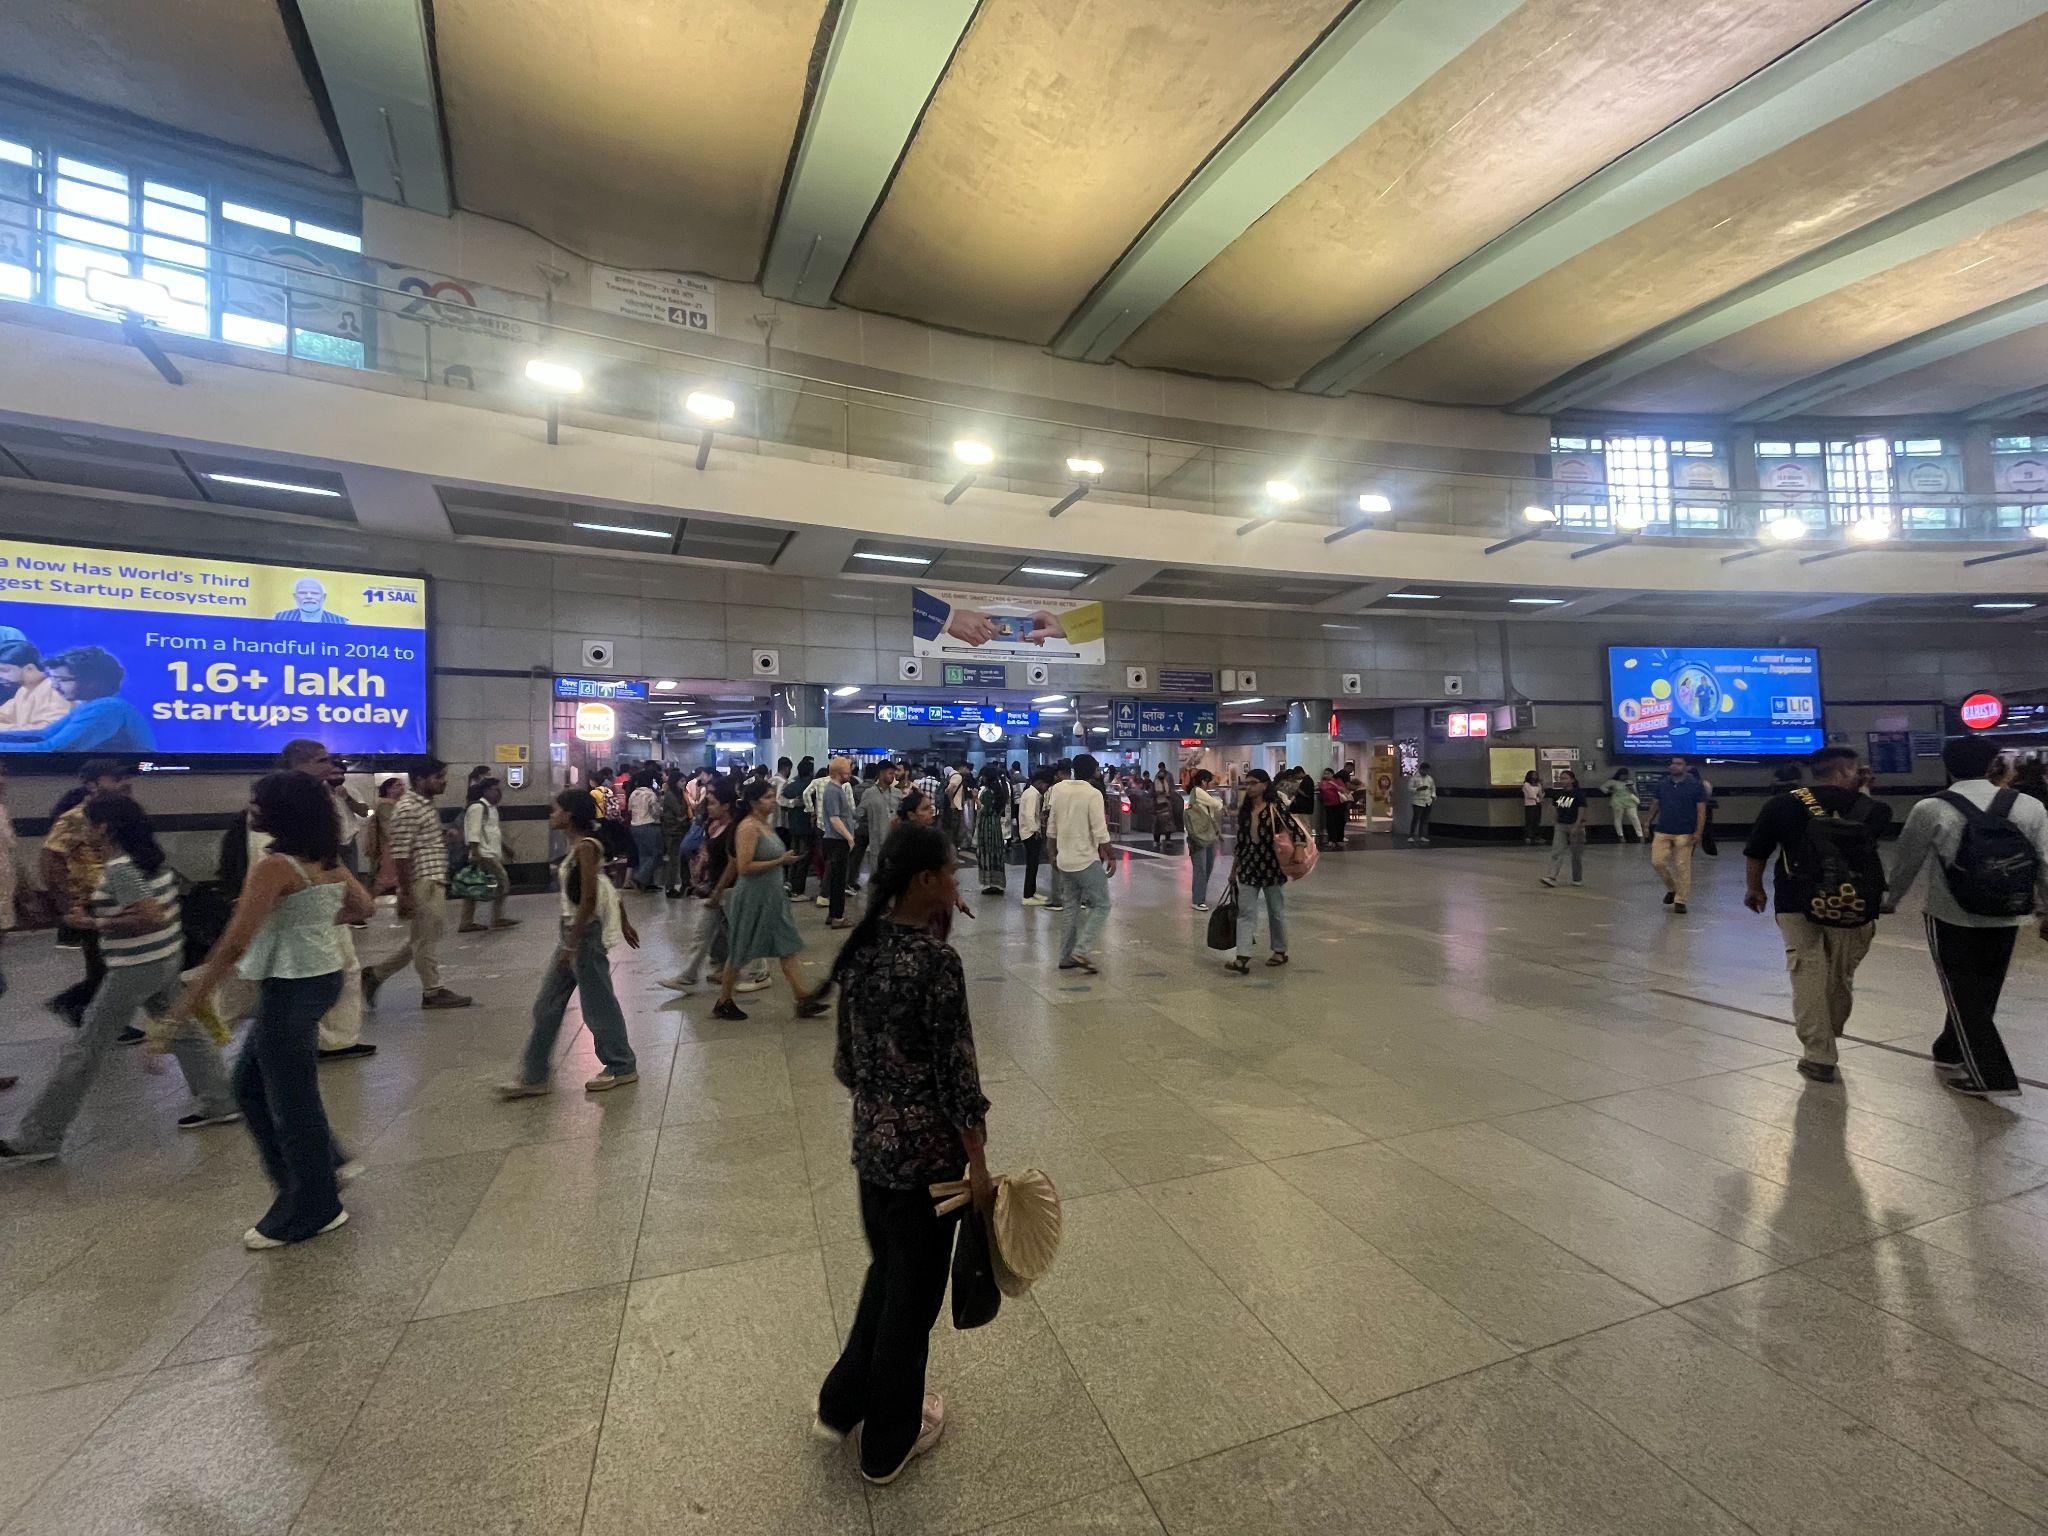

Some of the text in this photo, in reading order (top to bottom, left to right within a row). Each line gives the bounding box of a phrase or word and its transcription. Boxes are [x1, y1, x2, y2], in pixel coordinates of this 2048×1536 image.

[671, 310, 683, 323] 4
[16, 556, 66, 573] Now
[72, 562, 113, 577] Has
[118, 565, 194, 584] World's
[199, 573, 250, 589] Third
[49, 579, 134, 600] Startup
[140, 586, 247, 607] Ecosystem
[362, 589, 418, 604] 11 SAAL
[145, 632, 416, 660] From a handful in 2014 to
[167, 661, 386, 697] 1.6+ lakh
[1641, 703, 1670, 716] SMART
[1789, 699, 1809, 711] LIC
[152, 698, 409, 728] startups today
[1142, 723, 1165, 732] Block
[1173, 724, 1180, 732] A
[1206, 722, 1214, 734] 8
[1629, 717, 1667, 732] PENSION
